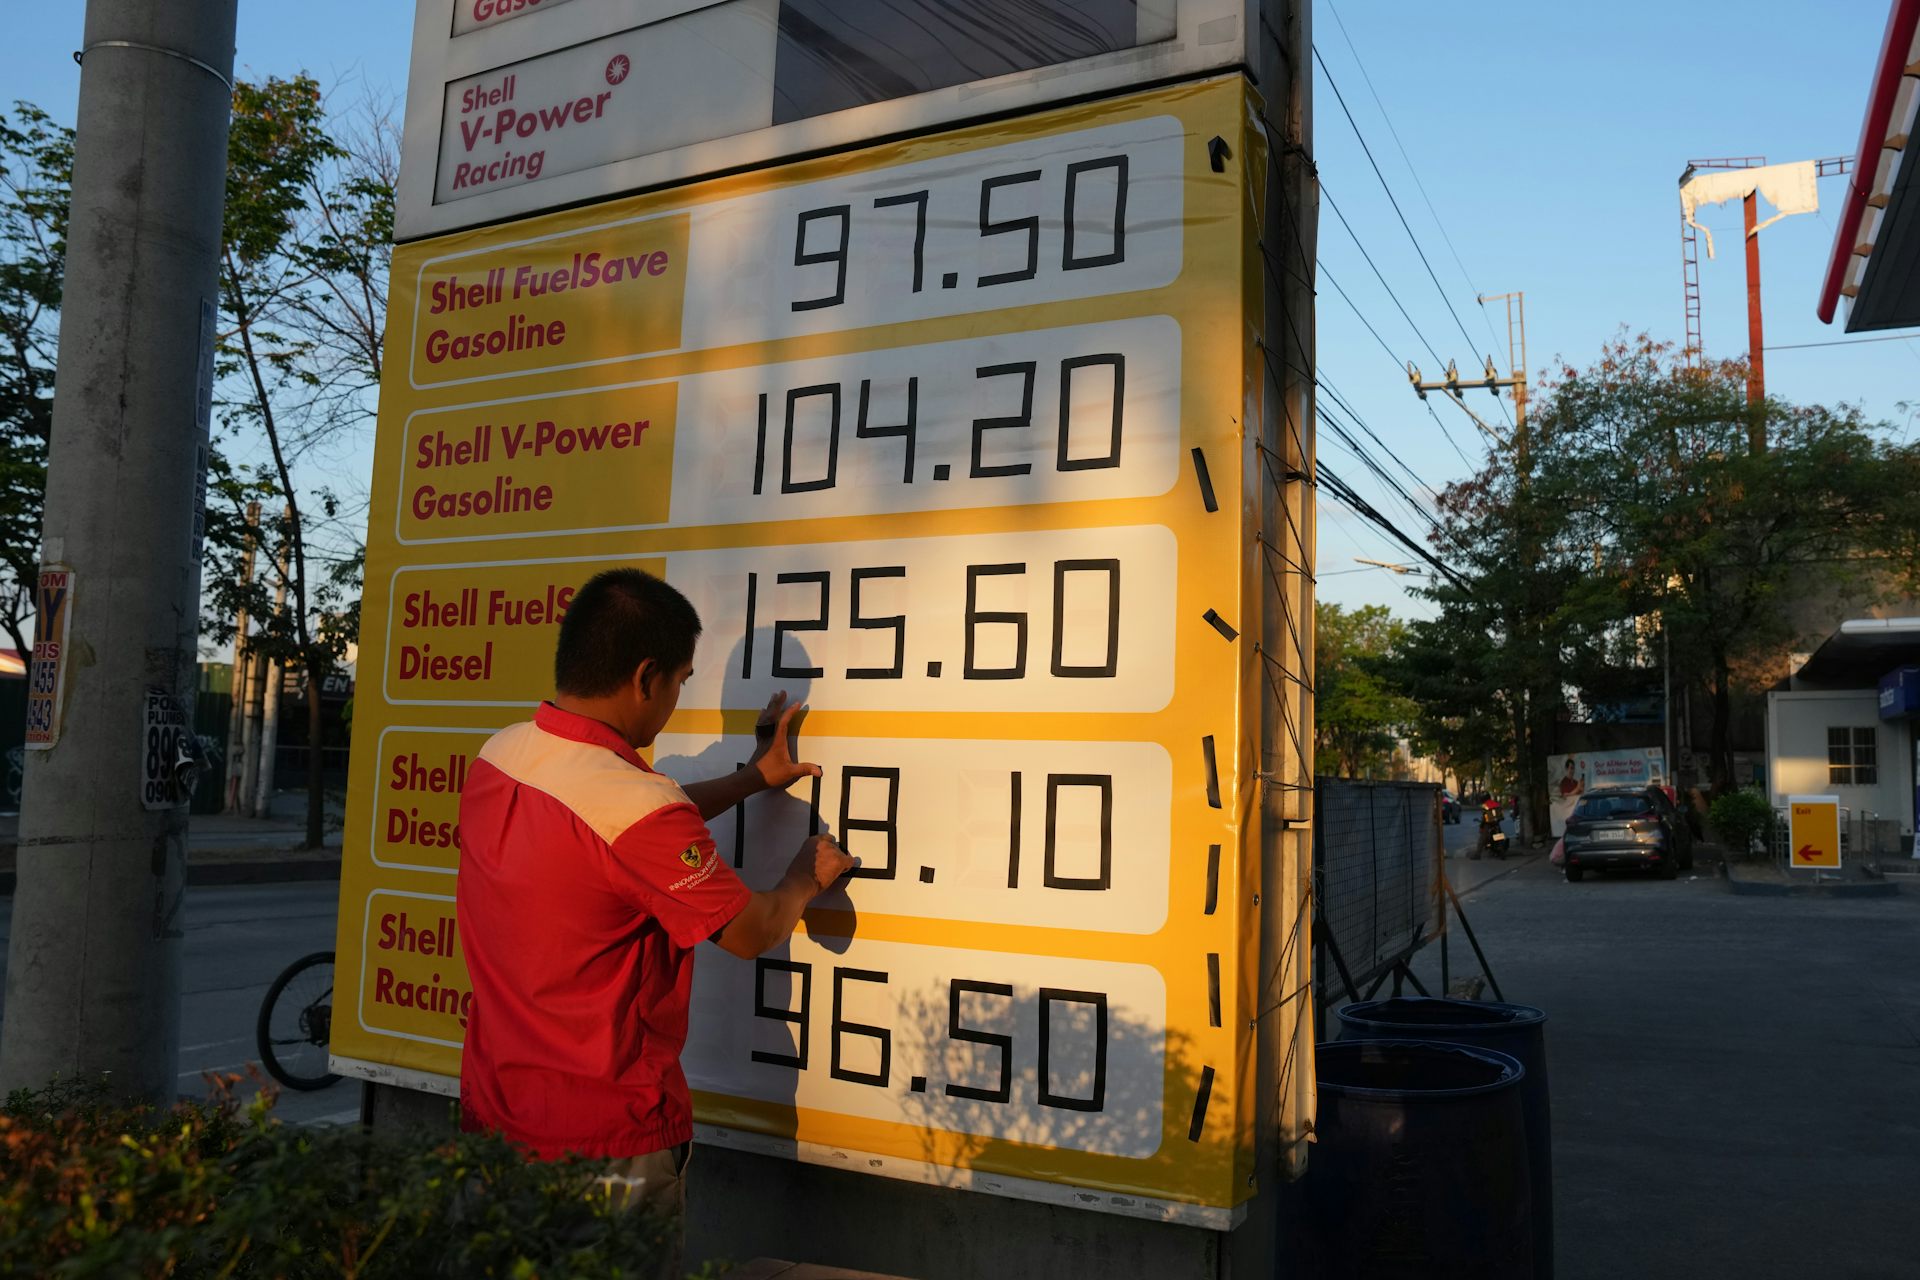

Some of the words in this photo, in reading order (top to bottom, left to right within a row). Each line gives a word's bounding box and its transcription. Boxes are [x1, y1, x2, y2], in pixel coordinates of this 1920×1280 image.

[461, 75, 515, 114] Shell
[460, 90, 612, 152] V-Power
[452, 150, 546, 190] Racing
[791, 154, 1129, 312] 97.50
[430, 268, 504, 315] Shell
[513, 250, 668, 300] FuelSave
[426, 314, 566, 364] Gasoline
[415, 425, 491, 469] Shell
[501, 419, 650, 460] V-Power
[753, 353, 1125, 495] 104.20
[412, 476, 553, 520] Gasoline
[403, 588, 479, 628] Shell
[488, 585, 575, 626] FuelS
[742, 558, 1121, 680] 125.60
[399, 642, 493, 681] Diesel
[390, 753, 466, 793] Shell
[1795, 807, 1811, 816] Exit
[378, 912, 456, 958] Shell
[751, 958, 1108, 1113] 96.50
